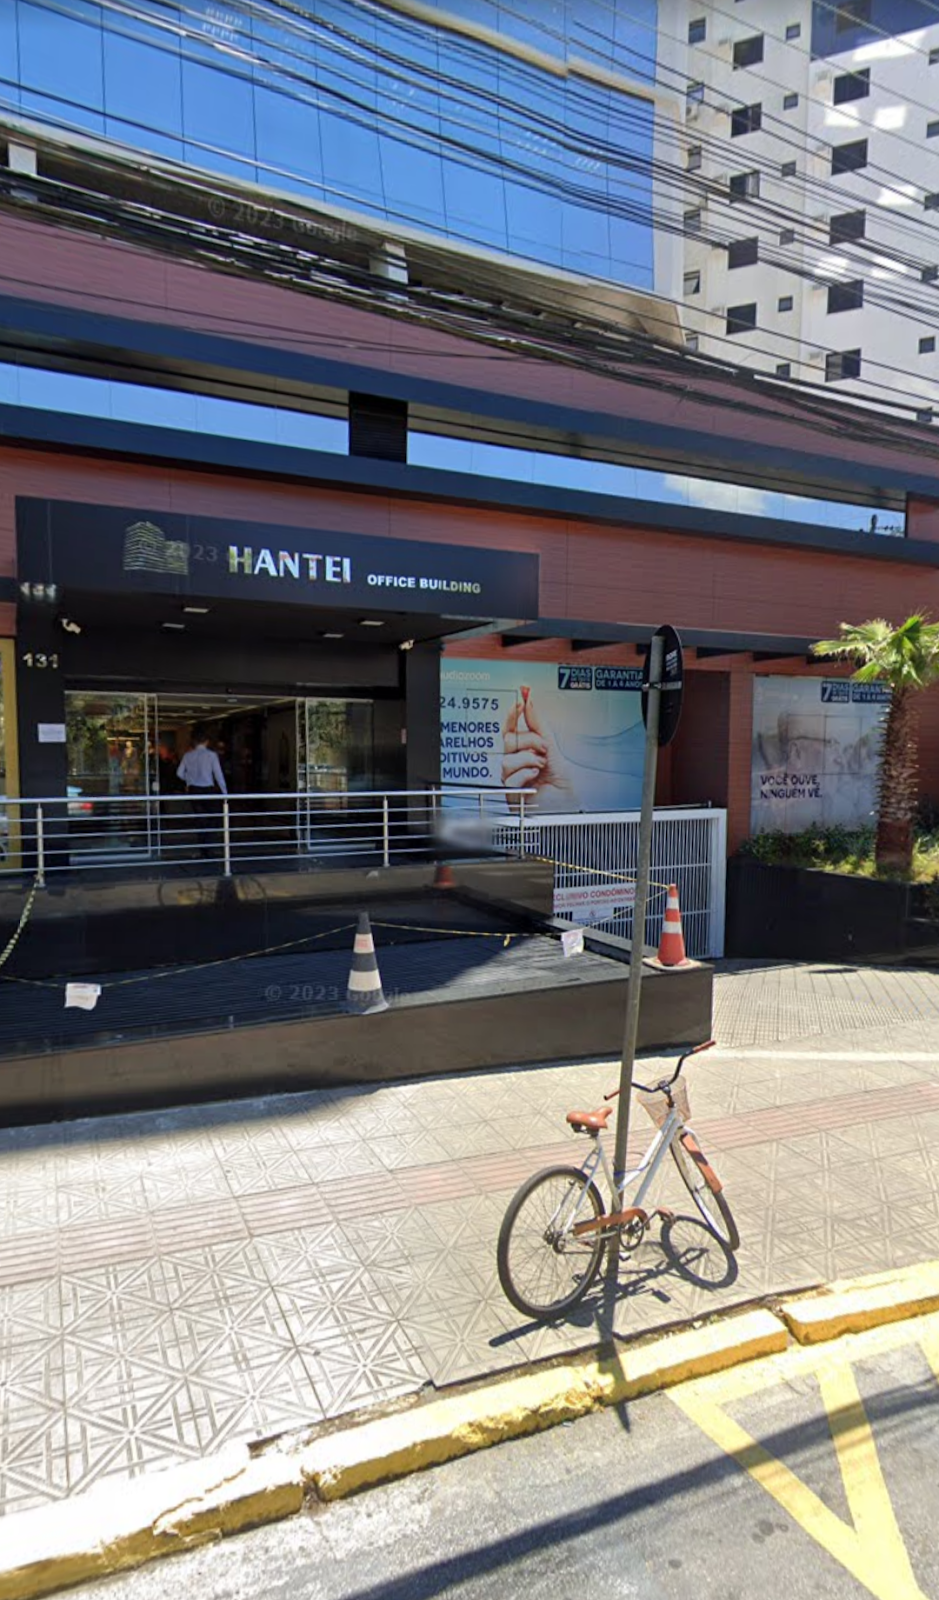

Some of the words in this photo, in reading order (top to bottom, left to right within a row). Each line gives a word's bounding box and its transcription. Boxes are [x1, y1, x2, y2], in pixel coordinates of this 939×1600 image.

[228, 546, 351, 584] HANTEI
[367, 574, 416, 588] OFFICE
[419, 578, 481, 594] BUILDING
[23, 653, 59, 669] 131
[560, 668, 571, 689] 7
[596, 669, 643, 680] GARANTIA
[822, 683, 833, 701] 7
[440, 721, 500, 733] MENORES
[443, 767, 493, 778] MUNDO.
